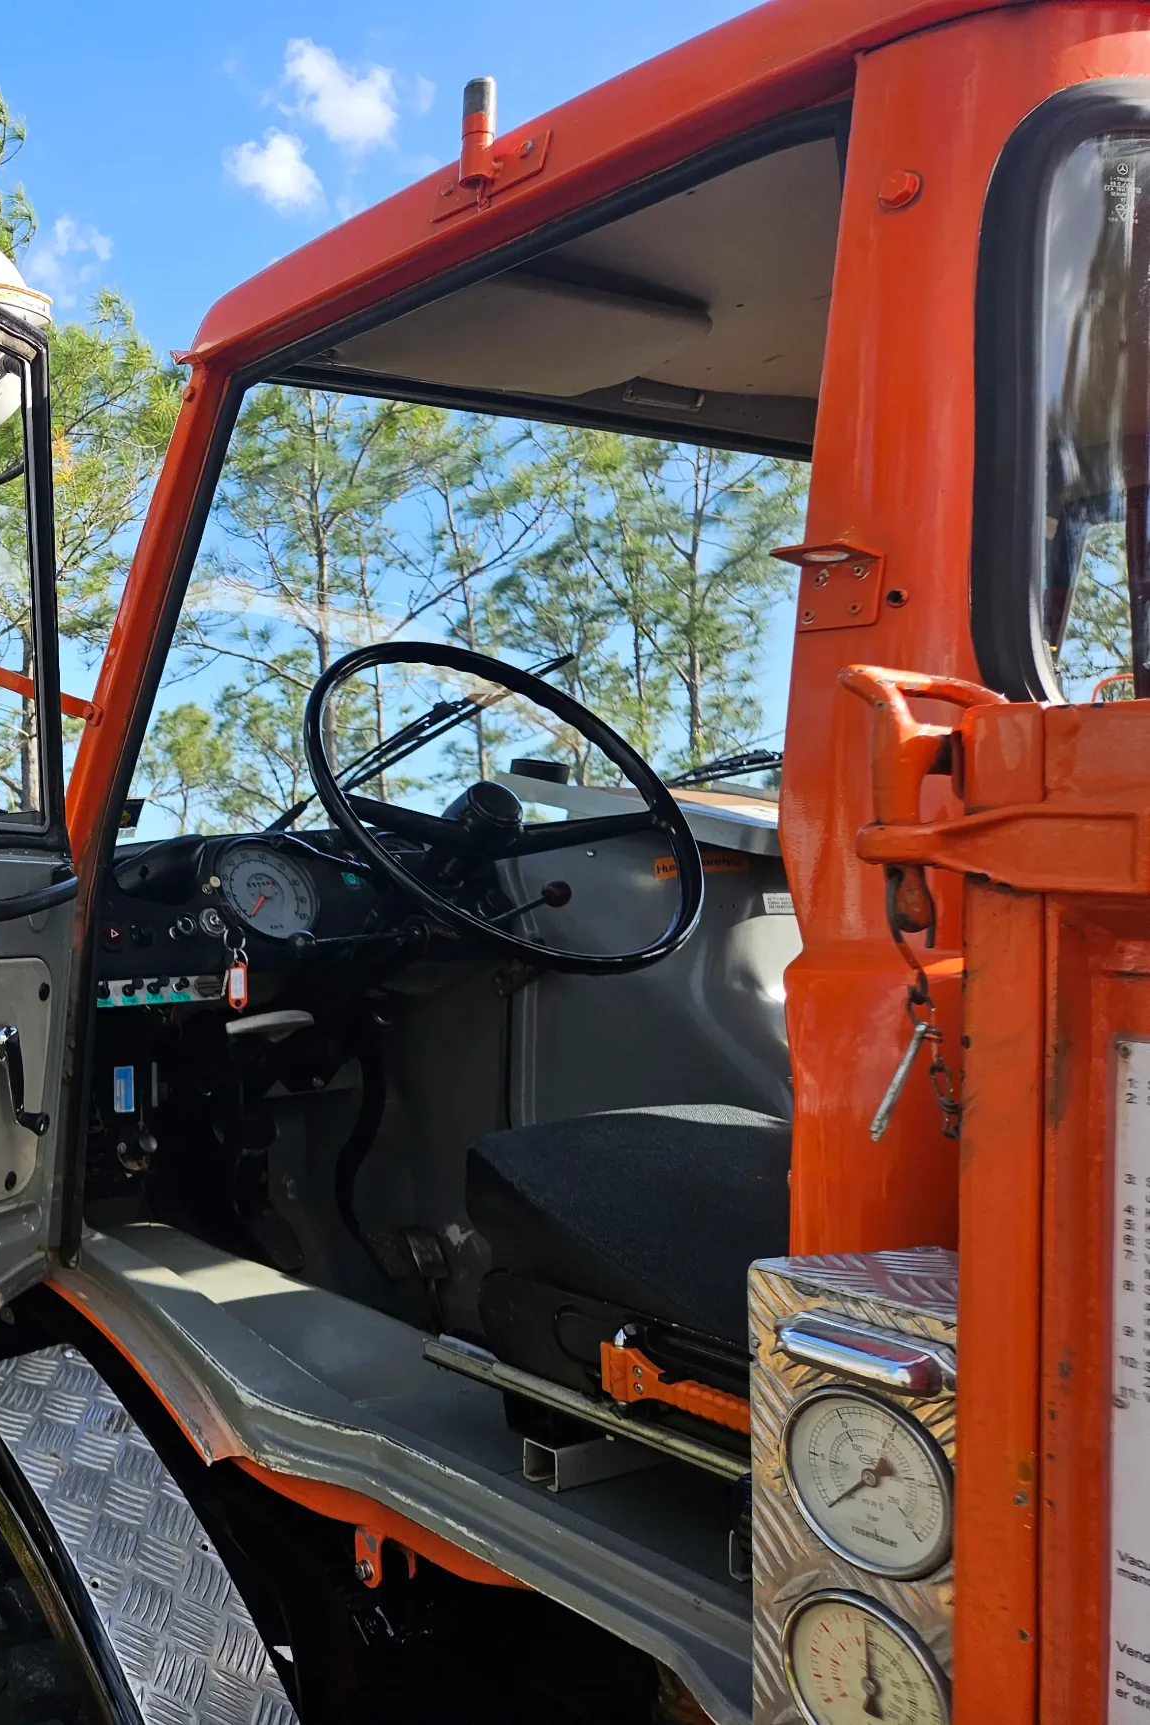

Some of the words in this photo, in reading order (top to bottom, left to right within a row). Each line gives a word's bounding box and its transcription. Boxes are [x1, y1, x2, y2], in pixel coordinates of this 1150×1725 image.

[840, 1420, 848, 1429] 10
[888, 1432, 895, 1440] 15
[852, 1443, 862, 1452] 100
[840, 1462, 849, 1471] 50
[852, 1524, 898, 1548] rosenbauer
[1115, 1688, 1130, 1700] er
